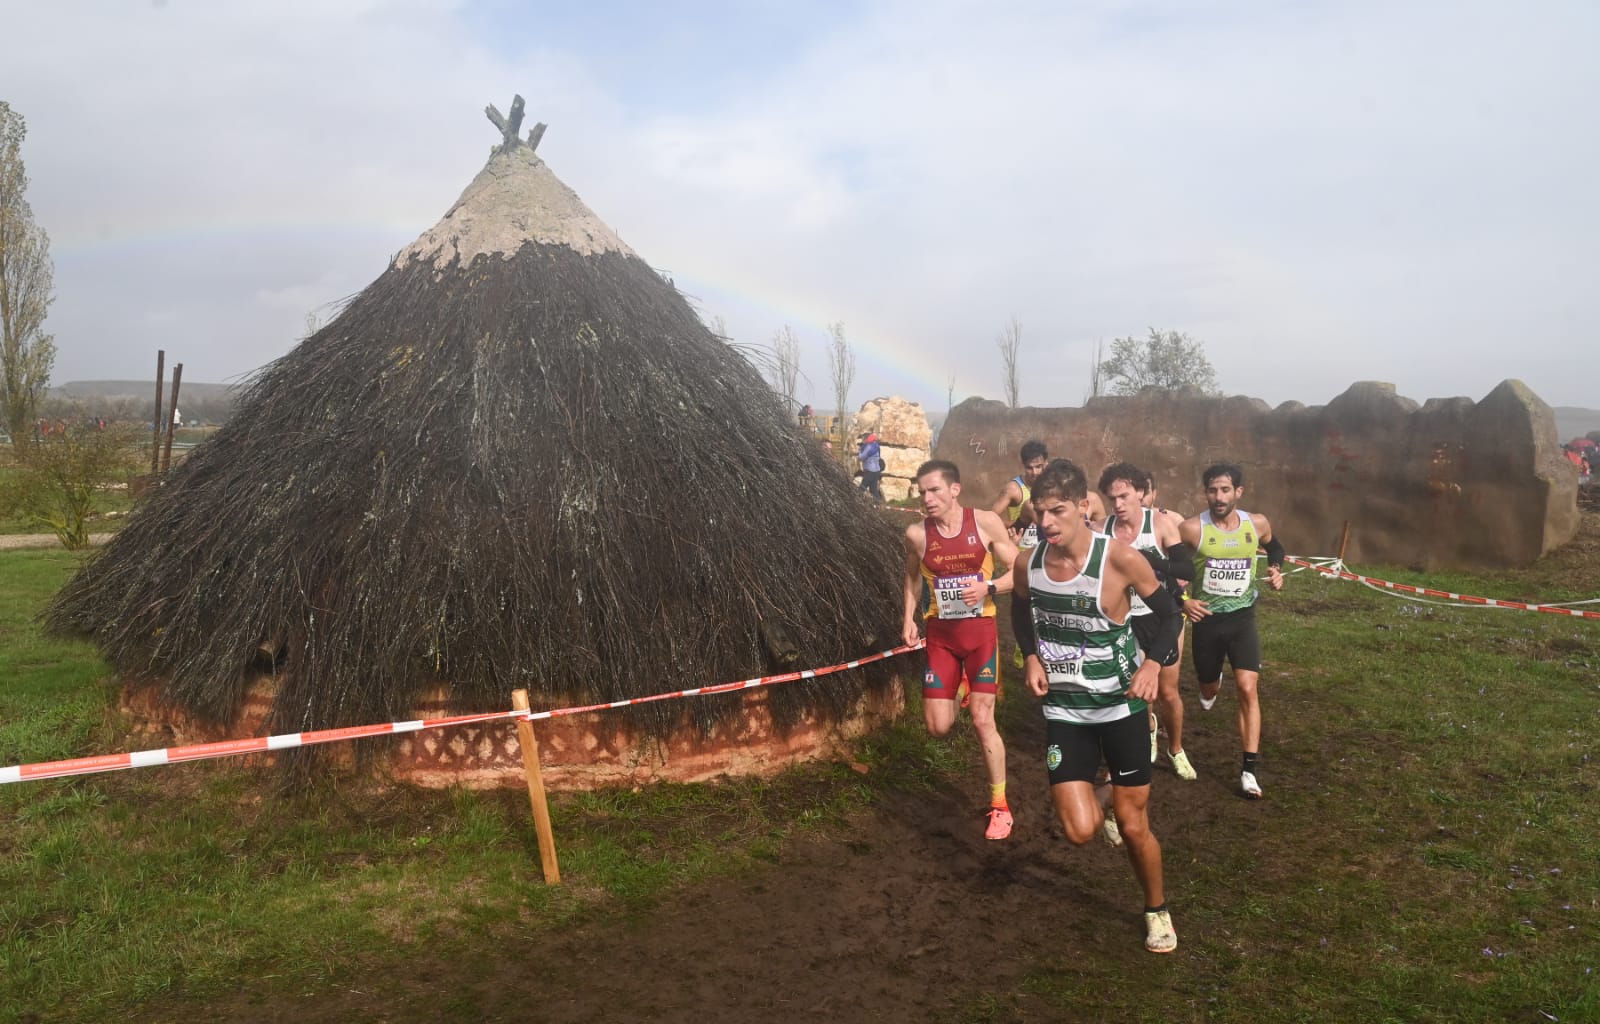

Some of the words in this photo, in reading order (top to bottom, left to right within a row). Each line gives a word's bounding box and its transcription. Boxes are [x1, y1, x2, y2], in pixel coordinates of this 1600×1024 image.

[1209, 569, 1246, 581] GOMEZ
[940, 589, 963, 602] BUE
[1044, 661, 1080, 676] EREIR
